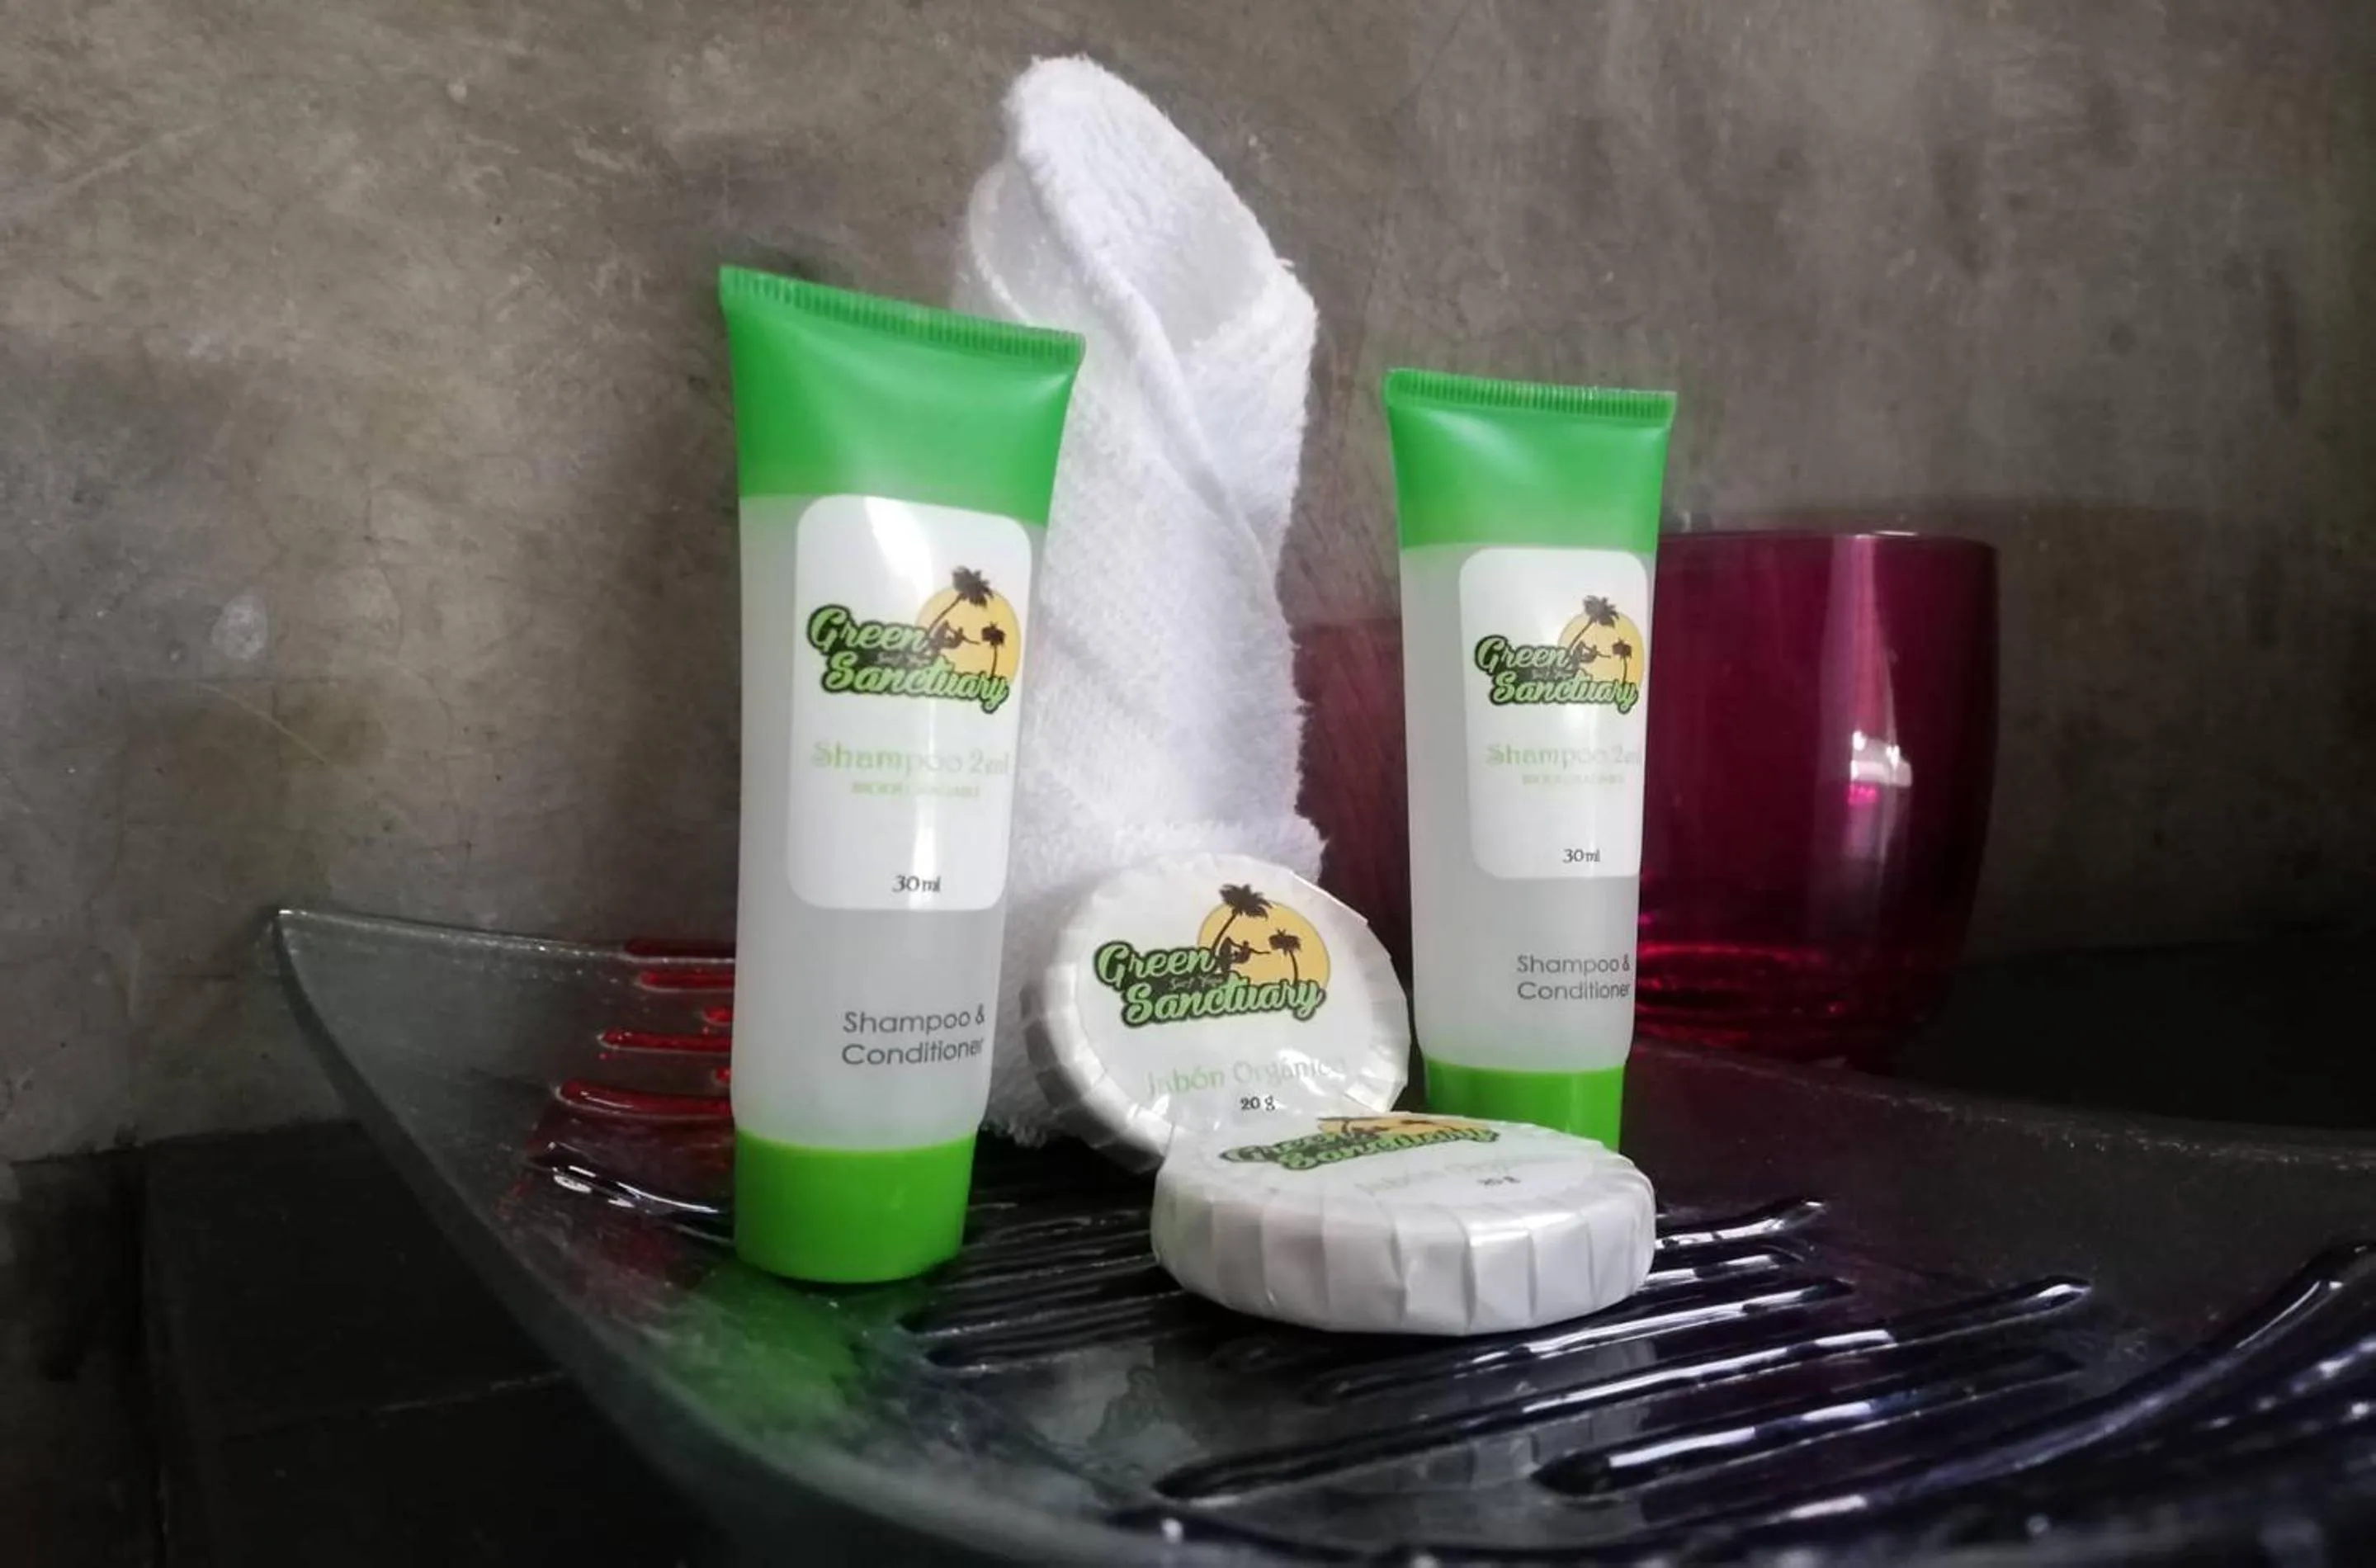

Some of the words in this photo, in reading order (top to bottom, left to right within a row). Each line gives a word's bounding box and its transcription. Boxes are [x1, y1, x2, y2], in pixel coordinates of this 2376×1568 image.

[807, 604, 931, 657] Green
[1474, 634, 1572, 677] Green
[822, 651, 1011, 714] Sanctuary
[1489, 669, 1639, 714] Sanctuary
[812, 740, 962, 777] Shampoo
[1094, 940, 1215, 989] Green
[1517, 954, 1619, 975] Shampoo
[1622, 954, 1631, 972] &
[1121, 972, 1327, 1028] Sanctuary
[1517, 980, 1631, 1000] Conditioner
[843, 1010, 971, 1035] Shampoo
[975, 1004, 985, 1025] &
[842, 1038, 984, 1065] Conditioner
[1240, 1096, 1260, 1111] 20
